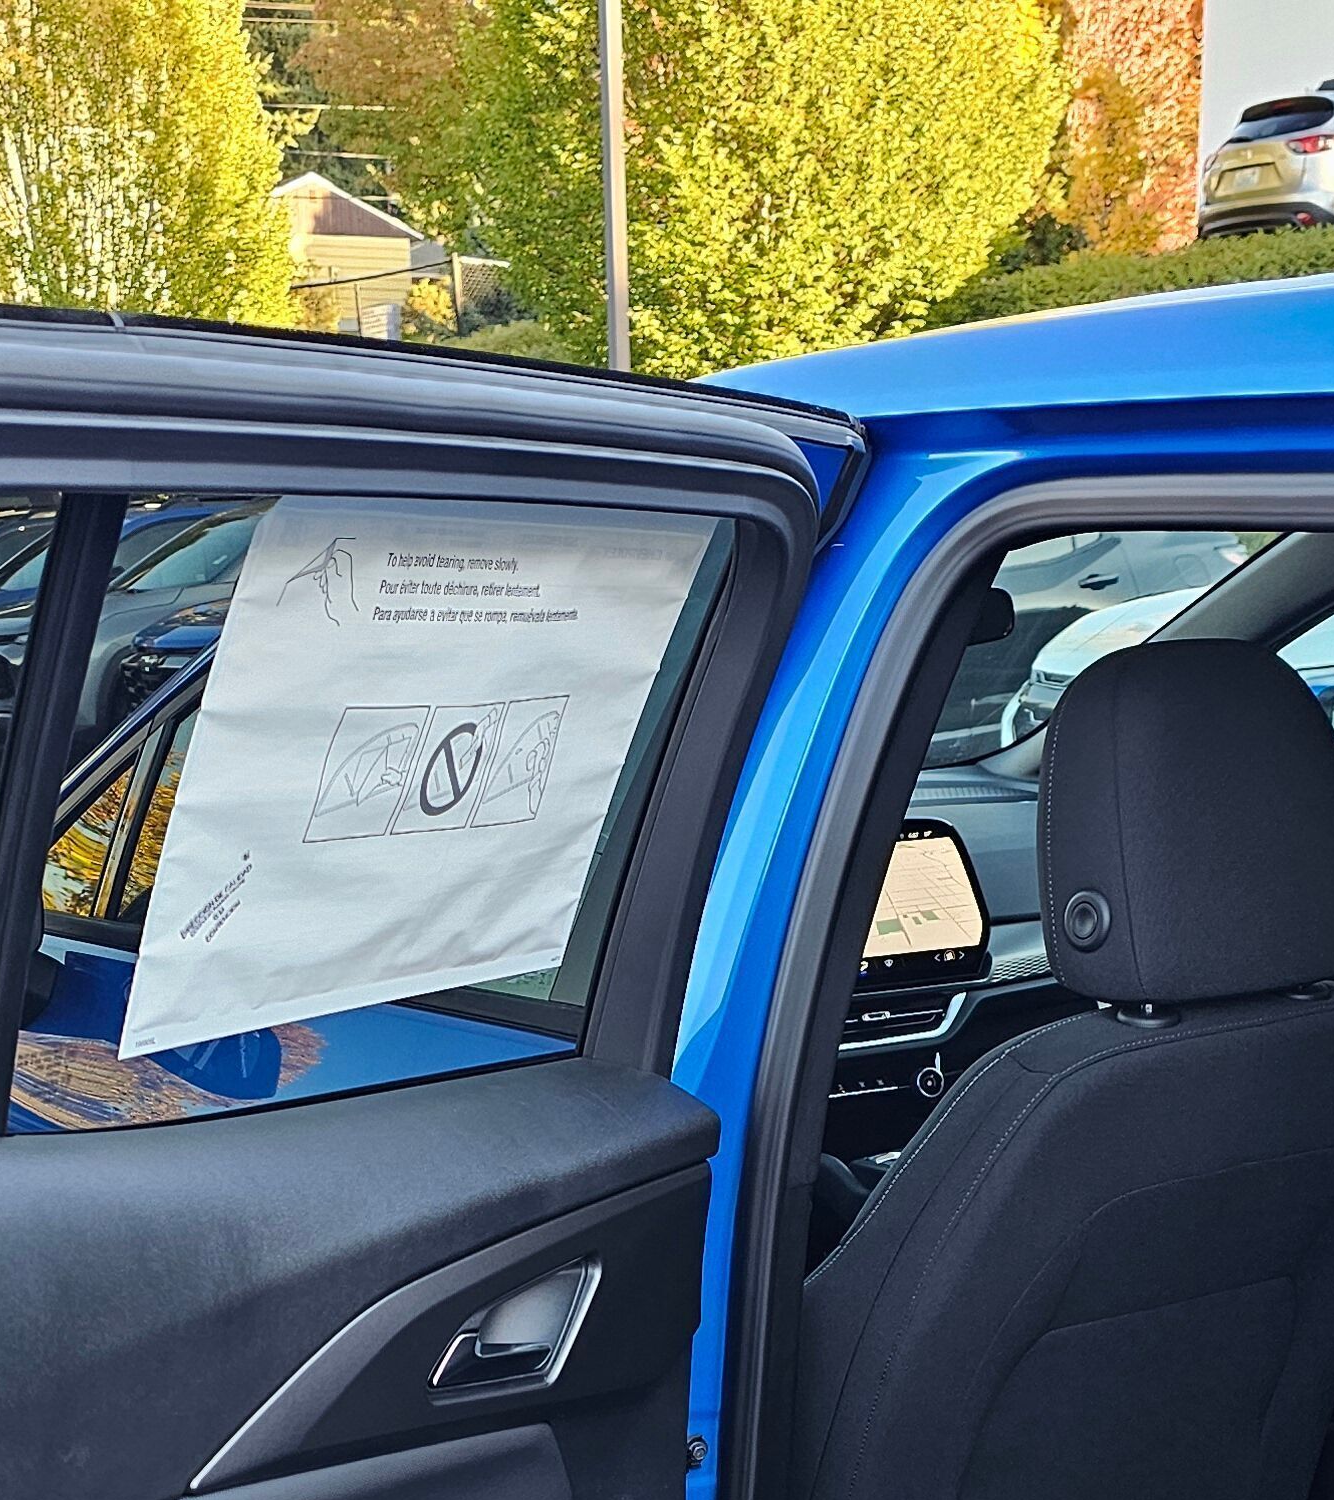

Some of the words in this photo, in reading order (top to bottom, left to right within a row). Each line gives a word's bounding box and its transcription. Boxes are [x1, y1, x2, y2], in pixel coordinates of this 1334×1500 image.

[387, 552, 397, 567] To
[398, 553, 413, 570] help
[414, 553, 434, 568] avoid
[436, 555, 465, 572] tearing,
[467, 558, 493, 570] remove
[379, 580, 398, 594] Pour
[400, 580, 419, 594] éviter
[421, 581, 441, 595] toute
[481, 583, 504, 597] retirer
[372, 606, 393, 621] Para
[393, 607, 427, 623] ayudarse
[429, 610, 434, 621] a
[437, 607, 459, 622] evitar
[459, 610, 473, 624] que
[474, 610, 482, 622] se
